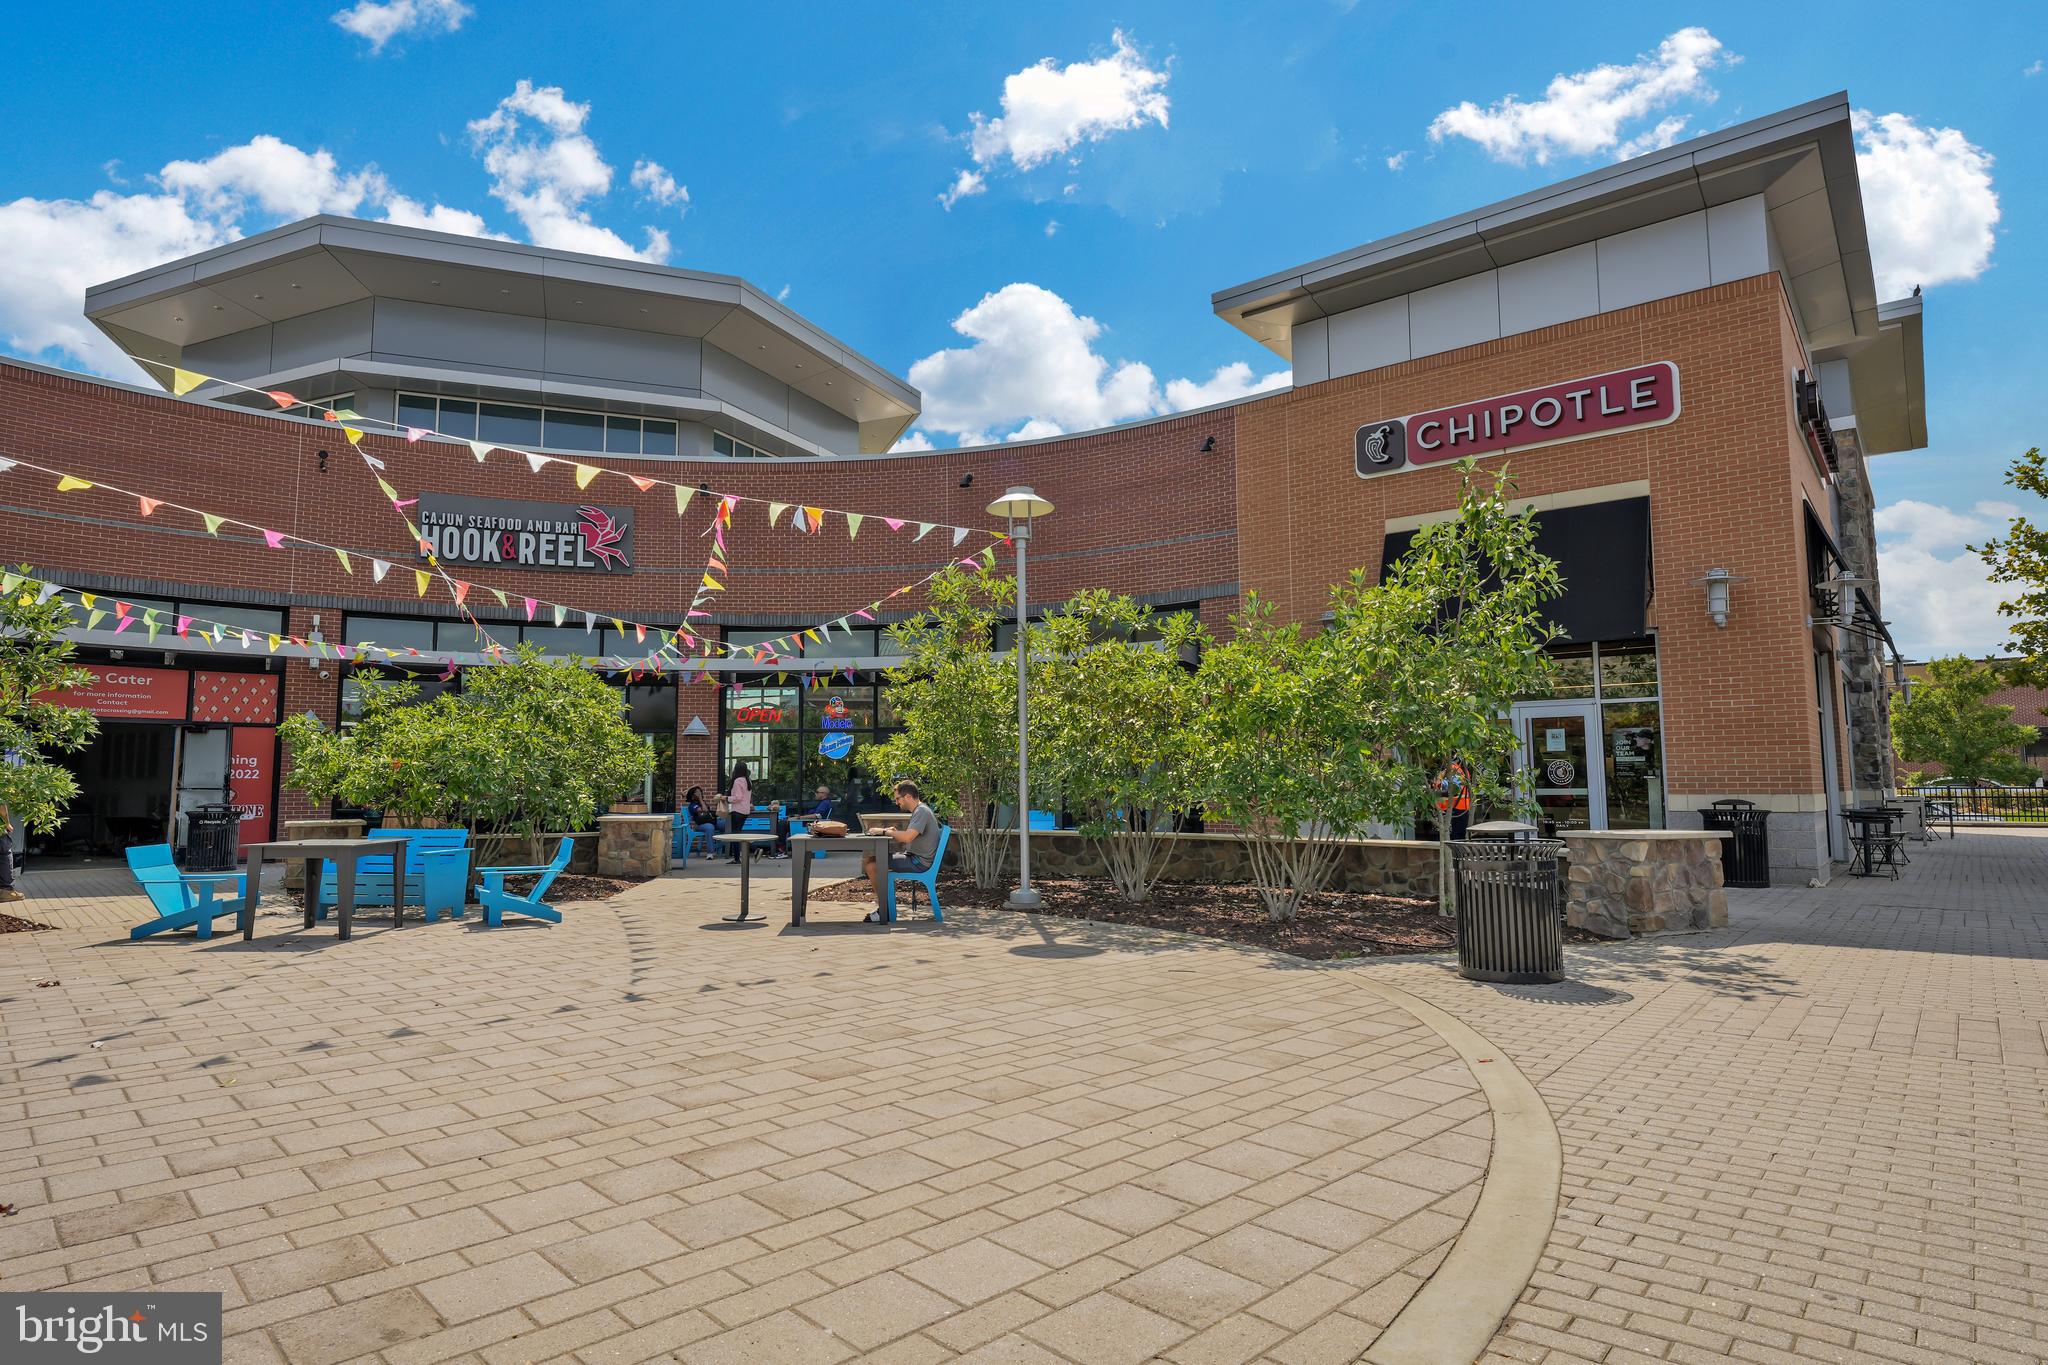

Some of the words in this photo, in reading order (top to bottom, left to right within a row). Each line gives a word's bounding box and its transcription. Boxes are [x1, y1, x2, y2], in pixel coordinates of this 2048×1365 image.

[1416, 375, 1657, 449] CHIPOTLE
[421, 511, 463, 527] CAJUN
[468, 515, 522, 531] SEAFOOD
[527, 519, 551, 533] AND
[555, 521, 578, 534] BAR
[105, 673, 153, 686] Cater
[96, 698, 128, 706] Contact
[107, 691, 152, 700] information
[736, 707, 783, 724] OPEN
[821, 715, 853, 729] Modelo
